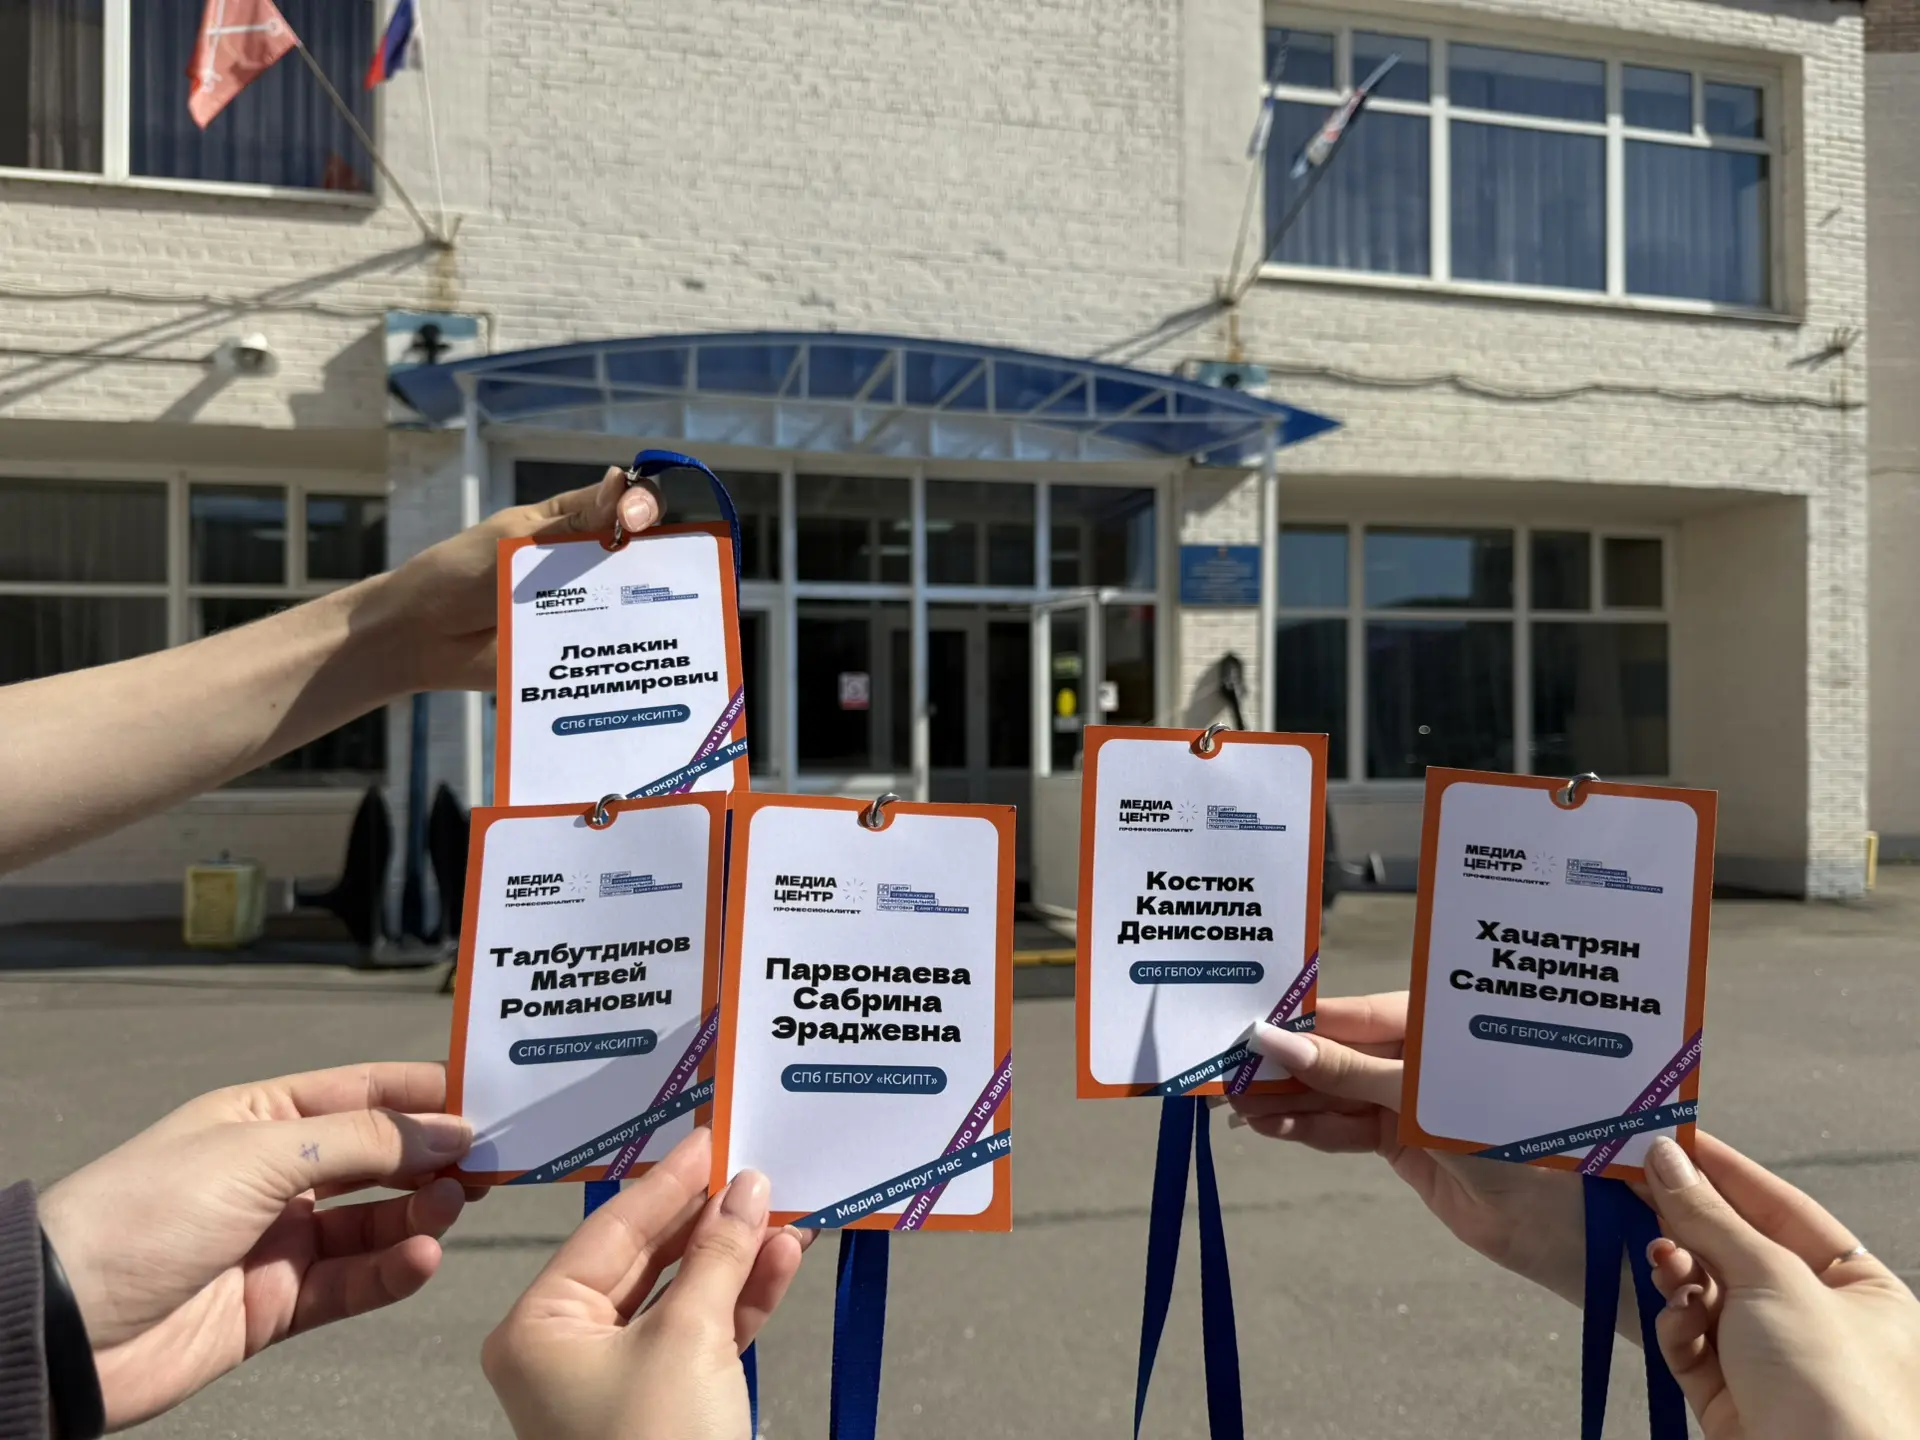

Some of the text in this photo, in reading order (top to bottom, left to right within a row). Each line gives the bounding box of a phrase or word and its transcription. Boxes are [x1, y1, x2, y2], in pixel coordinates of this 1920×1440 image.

[535, 587, 587, 599] МЕДИА
[536, 597, 585, 610] ЦЕНТР
[561, 639, 677, 661] Ломакин
[549, 656, 690, 680] Святослав
[521, 671, 718, 702] Владимирович
[560, 709, 683, 730] СПб ГБПОУ «КСИПТ»
[715, 721, 728, 734] Не
[645, 773, 684, 796] вокруг
[687, 762, 707, 776] нас
[1120, 799, 1173, 811] МЕДИА
[1119, 812, 1170, 824] ЦЕНТР
[1465, 844, 1526, 860] МЕДИА
[1464, 857, 1523, 872] ЦЕНТР
[507, 873, 564, 886] МЕДИА
[775, 875, 837, 889] МЕДИА
[1147, 871, 1255, 892] Костюк
[505, 898, 585, 907] ПРОФЕССИОНАЛИТЕТ
[506, 886, 560, 900] ЦЕНТР
[774, 890, 833, 903] ЦЕНТР
[1136, 896, 1262, 917] Камилла
[1117, 921, 1274, 944] Денисовна
[1476, 920, 1640, 958] Хачатрян
[490, 937, 690, 969] Талбутдинов
[531, 961, 646, 991] Матвей
[766, 958, 971, 986] Парвонаева
[1138, 966, 1256, 977] СПб ГБПОУ «КСИПТ»
[1492, 948, 1619, 983] Карина
[793, 987, 942, 1017] Сабрина
[1286, 989, 1300, 1004] Не
[1450, 969, 1661, 1015] Самвеловна
[500, 989, 672, 1019] Романович
[772, 1016, 961, 1046] Эраджевна
[1479, 1021, 1623, 1049] СПб ГБПОУ «КСИПТ»
[518, 1036, 648, 1057] СПб ГБПОУ «КСИПТ»
[680, 1054, 696, 1072] Не
[1179, 1065, 1215, 1087] Медиа
[1217, 1049, 1247, 1069] вокру
[792, 1071, 937, 1085] СПб ГБПОУ «КСИПТ»
[1660, 1071, 1678, 1087] Не
[974, 1101, 991, 1119] Не
[552, 1148, 594, 1174] Медиа
[597, 1122, 640, 1151] вокруг
[644, 1109, 667, 1126] нас
[1519, 1138, 1565, 1155] Медиа
[1569, 1124, 1614, 1143] вокруг
[1619, 1118, 1644, 1130] нас
[836, 1193, 883, 1219] Медиа
[887, 1170, 933, 1197] вокруг
[937, 1158, 962, 1175] нас
